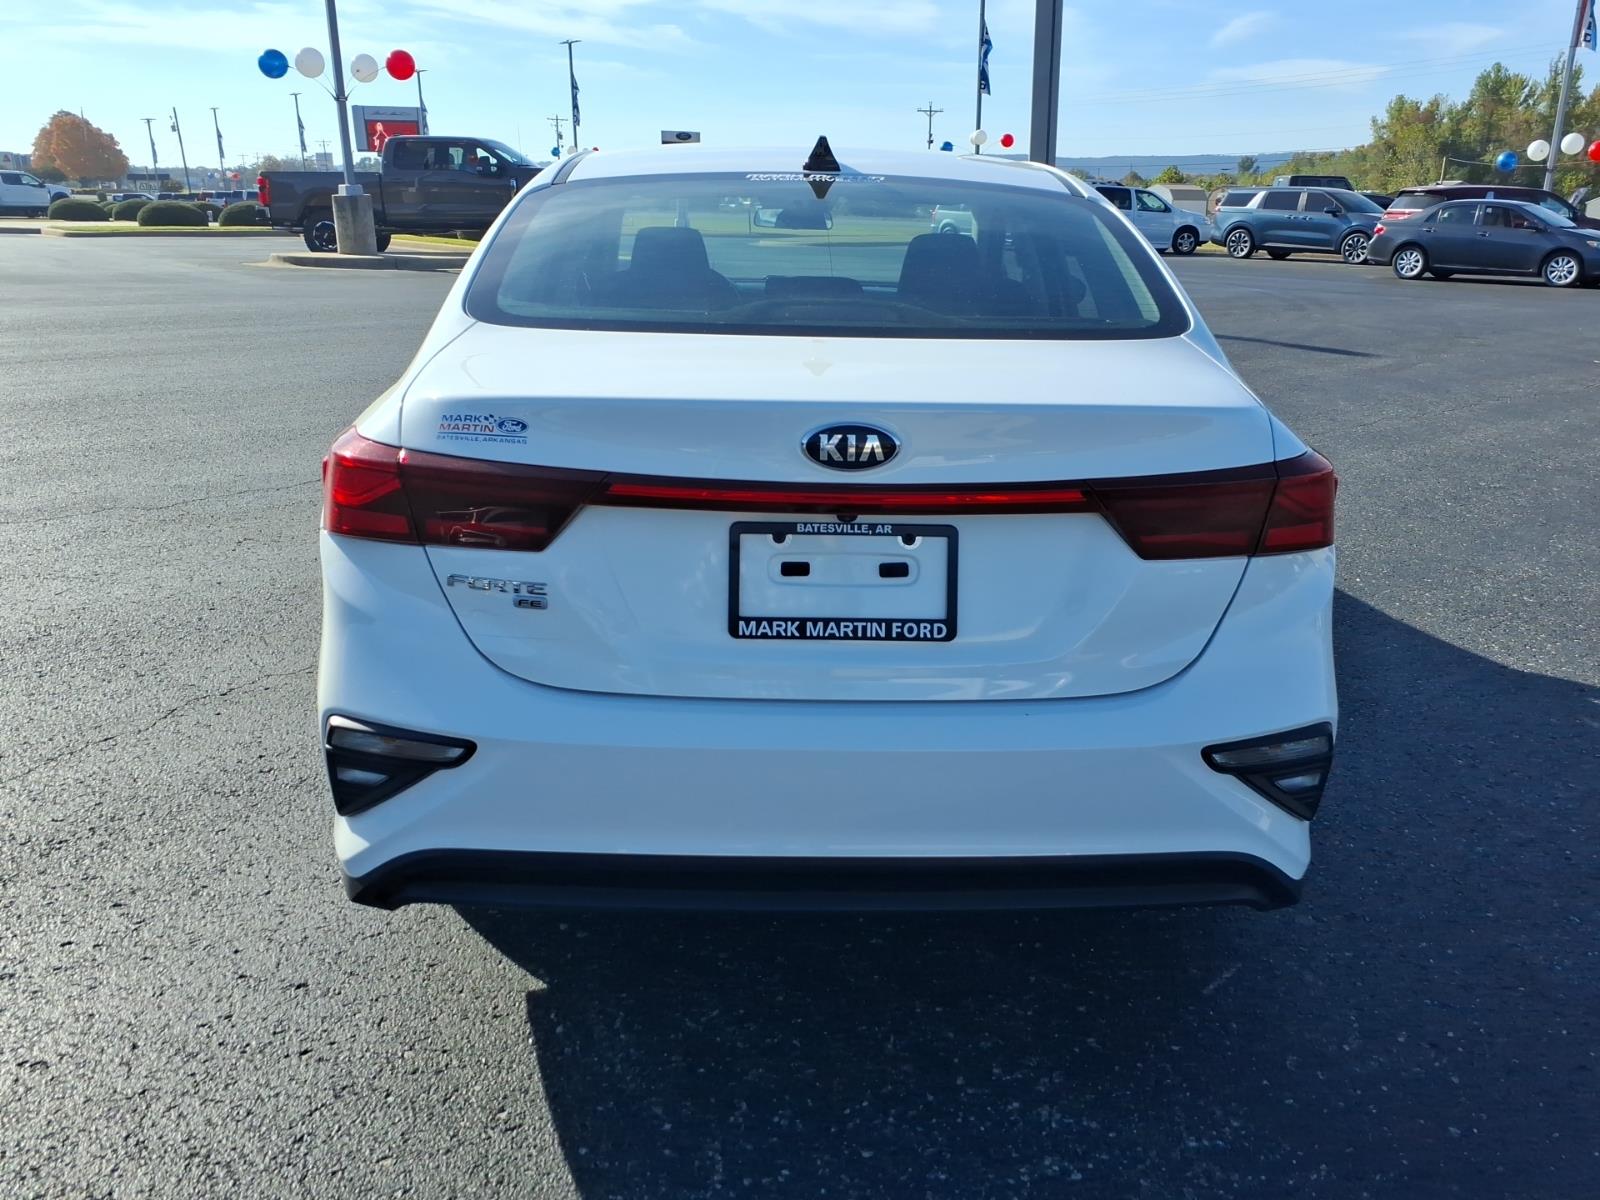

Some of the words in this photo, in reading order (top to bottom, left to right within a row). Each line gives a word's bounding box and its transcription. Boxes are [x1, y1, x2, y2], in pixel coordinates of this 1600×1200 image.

[441, 414, 482, 423] MARK
[439, 423, 496, 433] MARTIN
[818, 433, 885, 462] KIA
[796, 523, 872, 535] BATESVILLE,
[875, 524, 893, 534] AR
[447, 573, 548, 596] FORTE
[518, 599, 542, 608] FE
[738, 620, 800, 637] MARK
[806, 621, 886, 638] MARTIN
[891, 622, 947, 639] FORD
